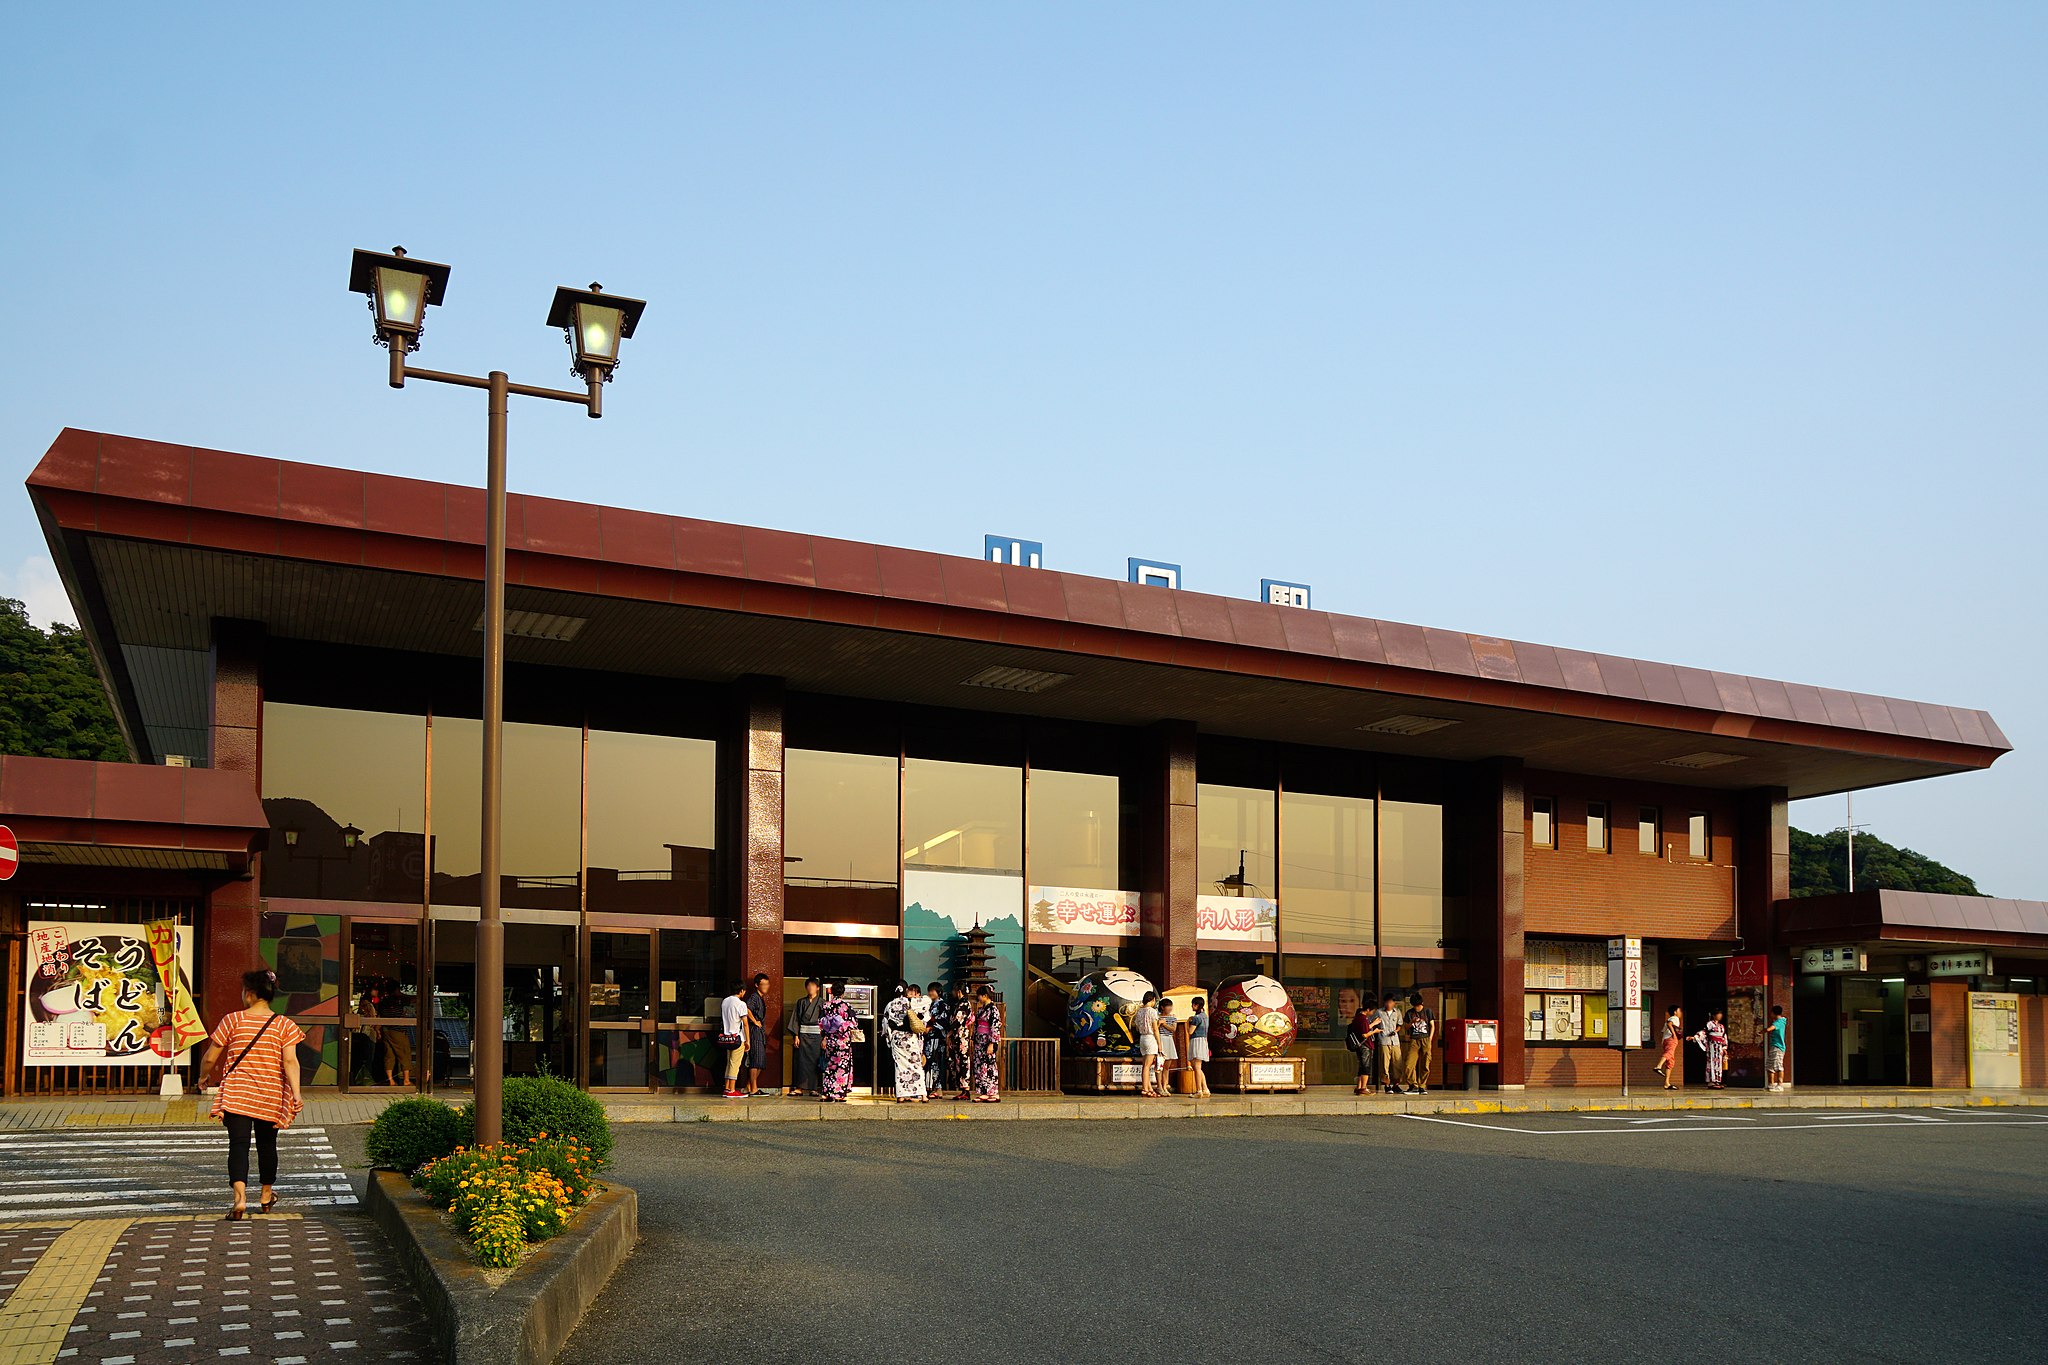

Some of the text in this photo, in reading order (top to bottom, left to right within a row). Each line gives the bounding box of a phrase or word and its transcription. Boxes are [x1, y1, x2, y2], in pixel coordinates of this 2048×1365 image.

[1057, 900, 1255, 931] 幸せ運ぶ 内人形
[36, 931, 57, 976] 地産地消
[54, 930, 69, 973] こだわり
[73, 937, 110, 1011] そば
[1729, 960, 1756, 975] バス
[111, 937, 146, 1050] うどん
[1629, 961, 1637, 1006] バスのりば
